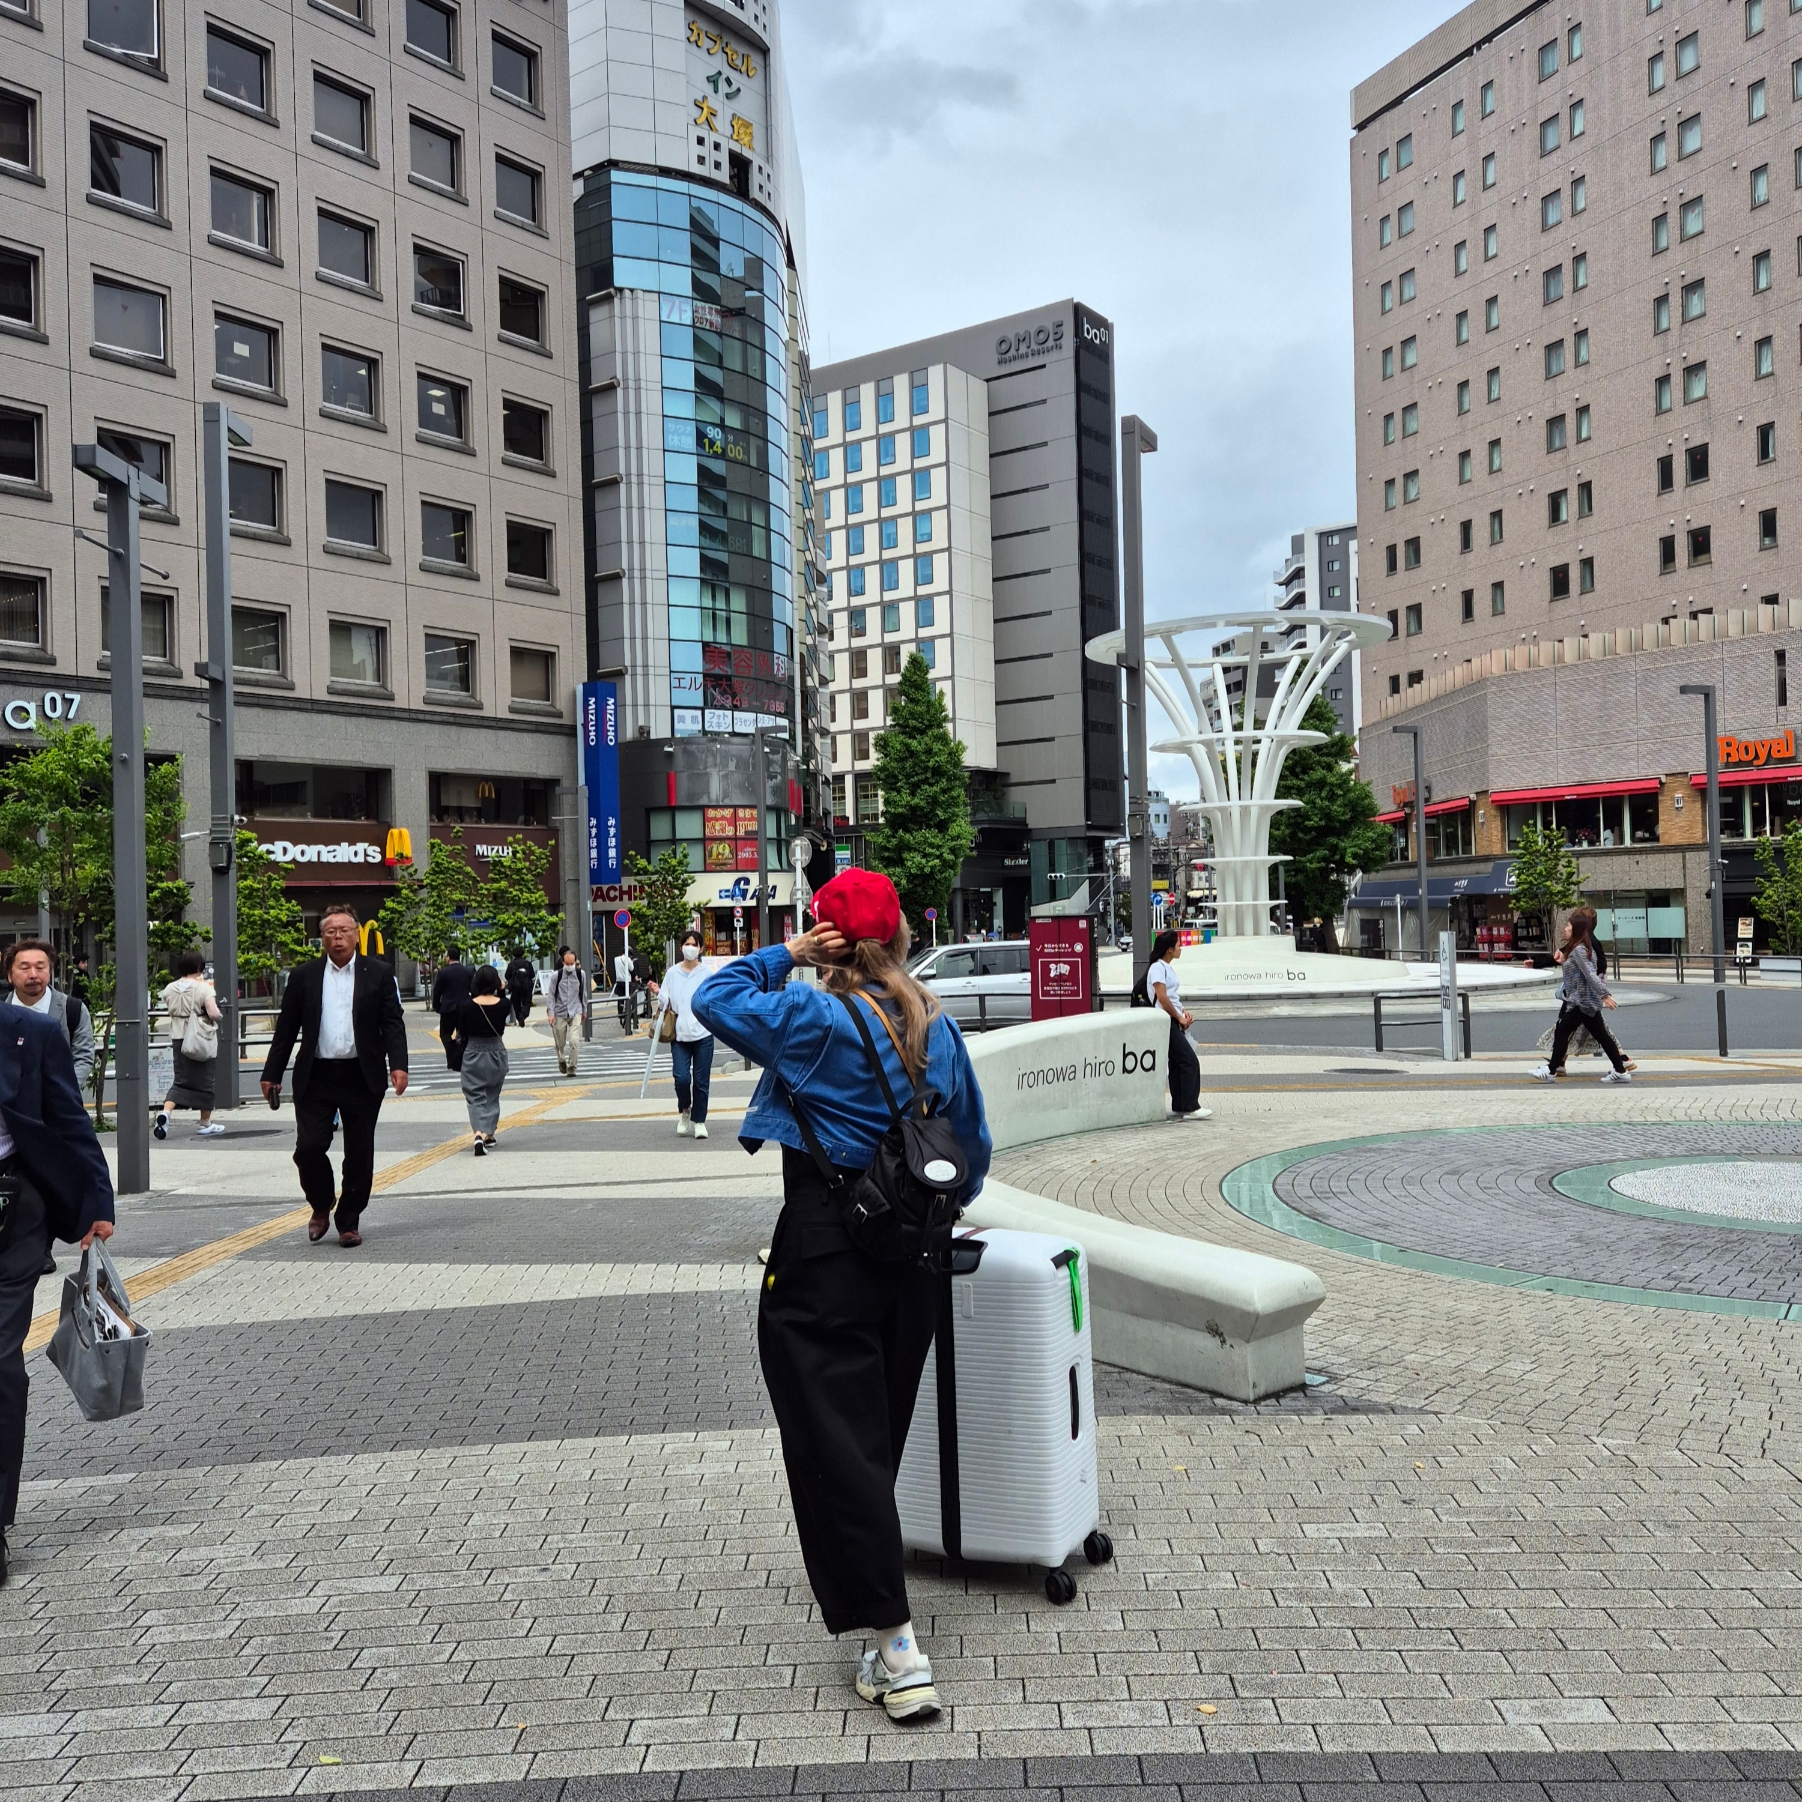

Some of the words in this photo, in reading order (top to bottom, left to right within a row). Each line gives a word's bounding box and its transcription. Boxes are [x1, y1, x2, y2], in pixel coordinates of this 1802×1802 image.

[687, 20, 757, 78] カプセル
[706, 70, 741, 100] イン
[694, 95, 755, 152] 大塚
[662, 299, 690, 322] 7F
[995, 319, 1064, 356] OMO5
[704, 645, 788, 682] 美容外科
[0, 691, 81, 730] a07
[588, 697, 596, 746] MIZUHO
[606, 697, 615, 746] MIZUHO
[1716, 729, 1795, 766] Royal
[246, 841, 382, 864] cDonald's
[475, 844, 512, 857] MIZUH
[589, 816, 598, 870] みずほ銀行
[607, 816, 617, 869] みずほ銀行
[1004, 857, 1029, 866] Sizzler
[1224, 972, 1262, 981] ironowa
[1265, 970, 1284, 980] hiro
[1286, 968, 1306, 981] ba
[1017, 1064, 1077, 1091] ironowa
[1083, 1056, 1115, 1080] hiro
[1122, 1042, 1156, 1075] ba
